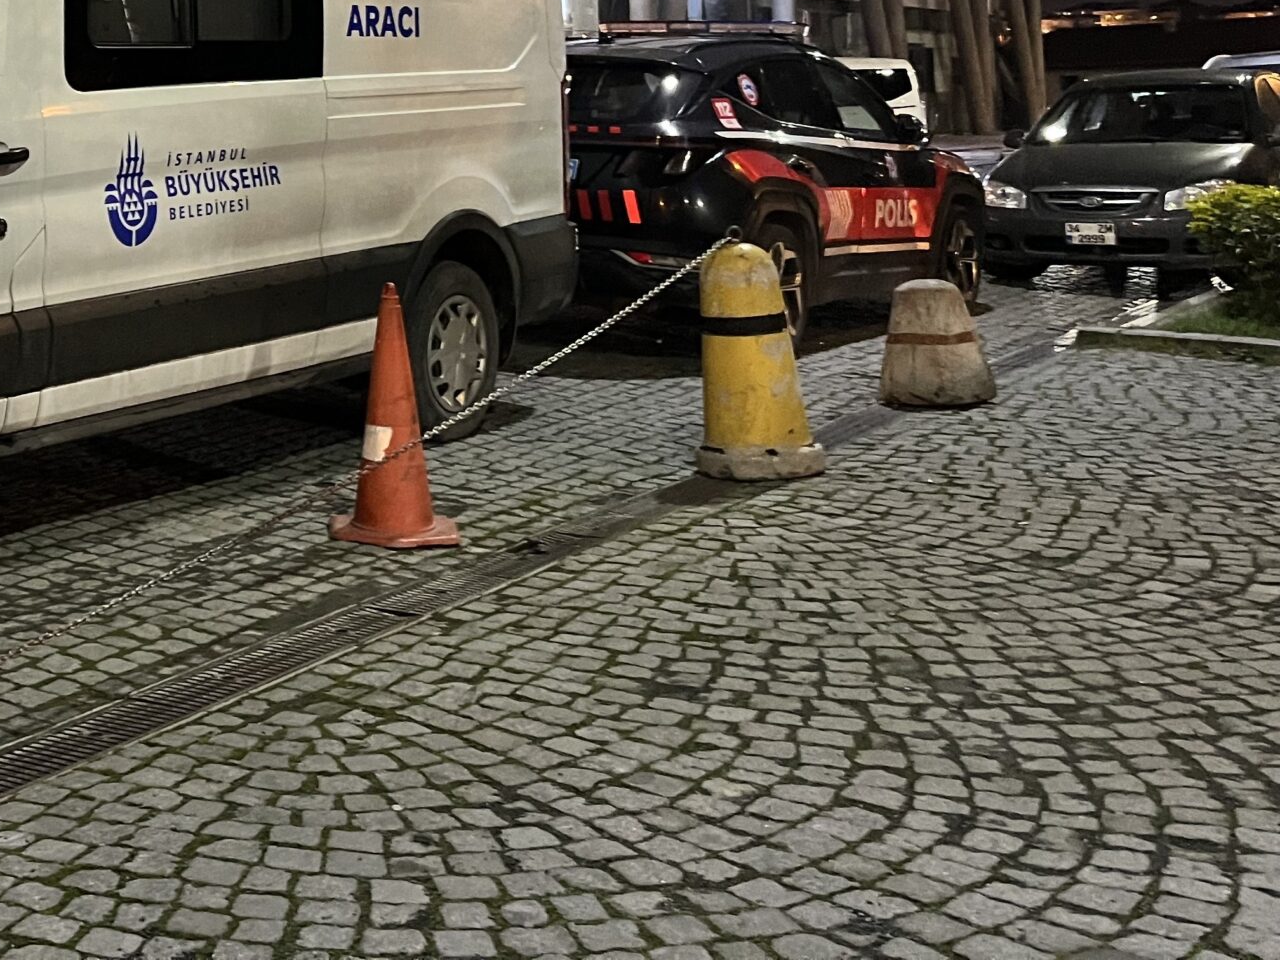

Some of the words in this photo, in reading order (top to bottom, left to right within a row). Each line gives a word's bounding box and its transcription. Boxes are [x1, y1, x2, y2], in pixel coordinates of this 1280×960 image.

[346, 4, 420, 38] ARACI
[166, 147, 247, 167] İSTANBUL
[164, 161, 281, 197] BÜYÜKŞEHİR
[168, 195, 249, 221] BELEDİYESİ
